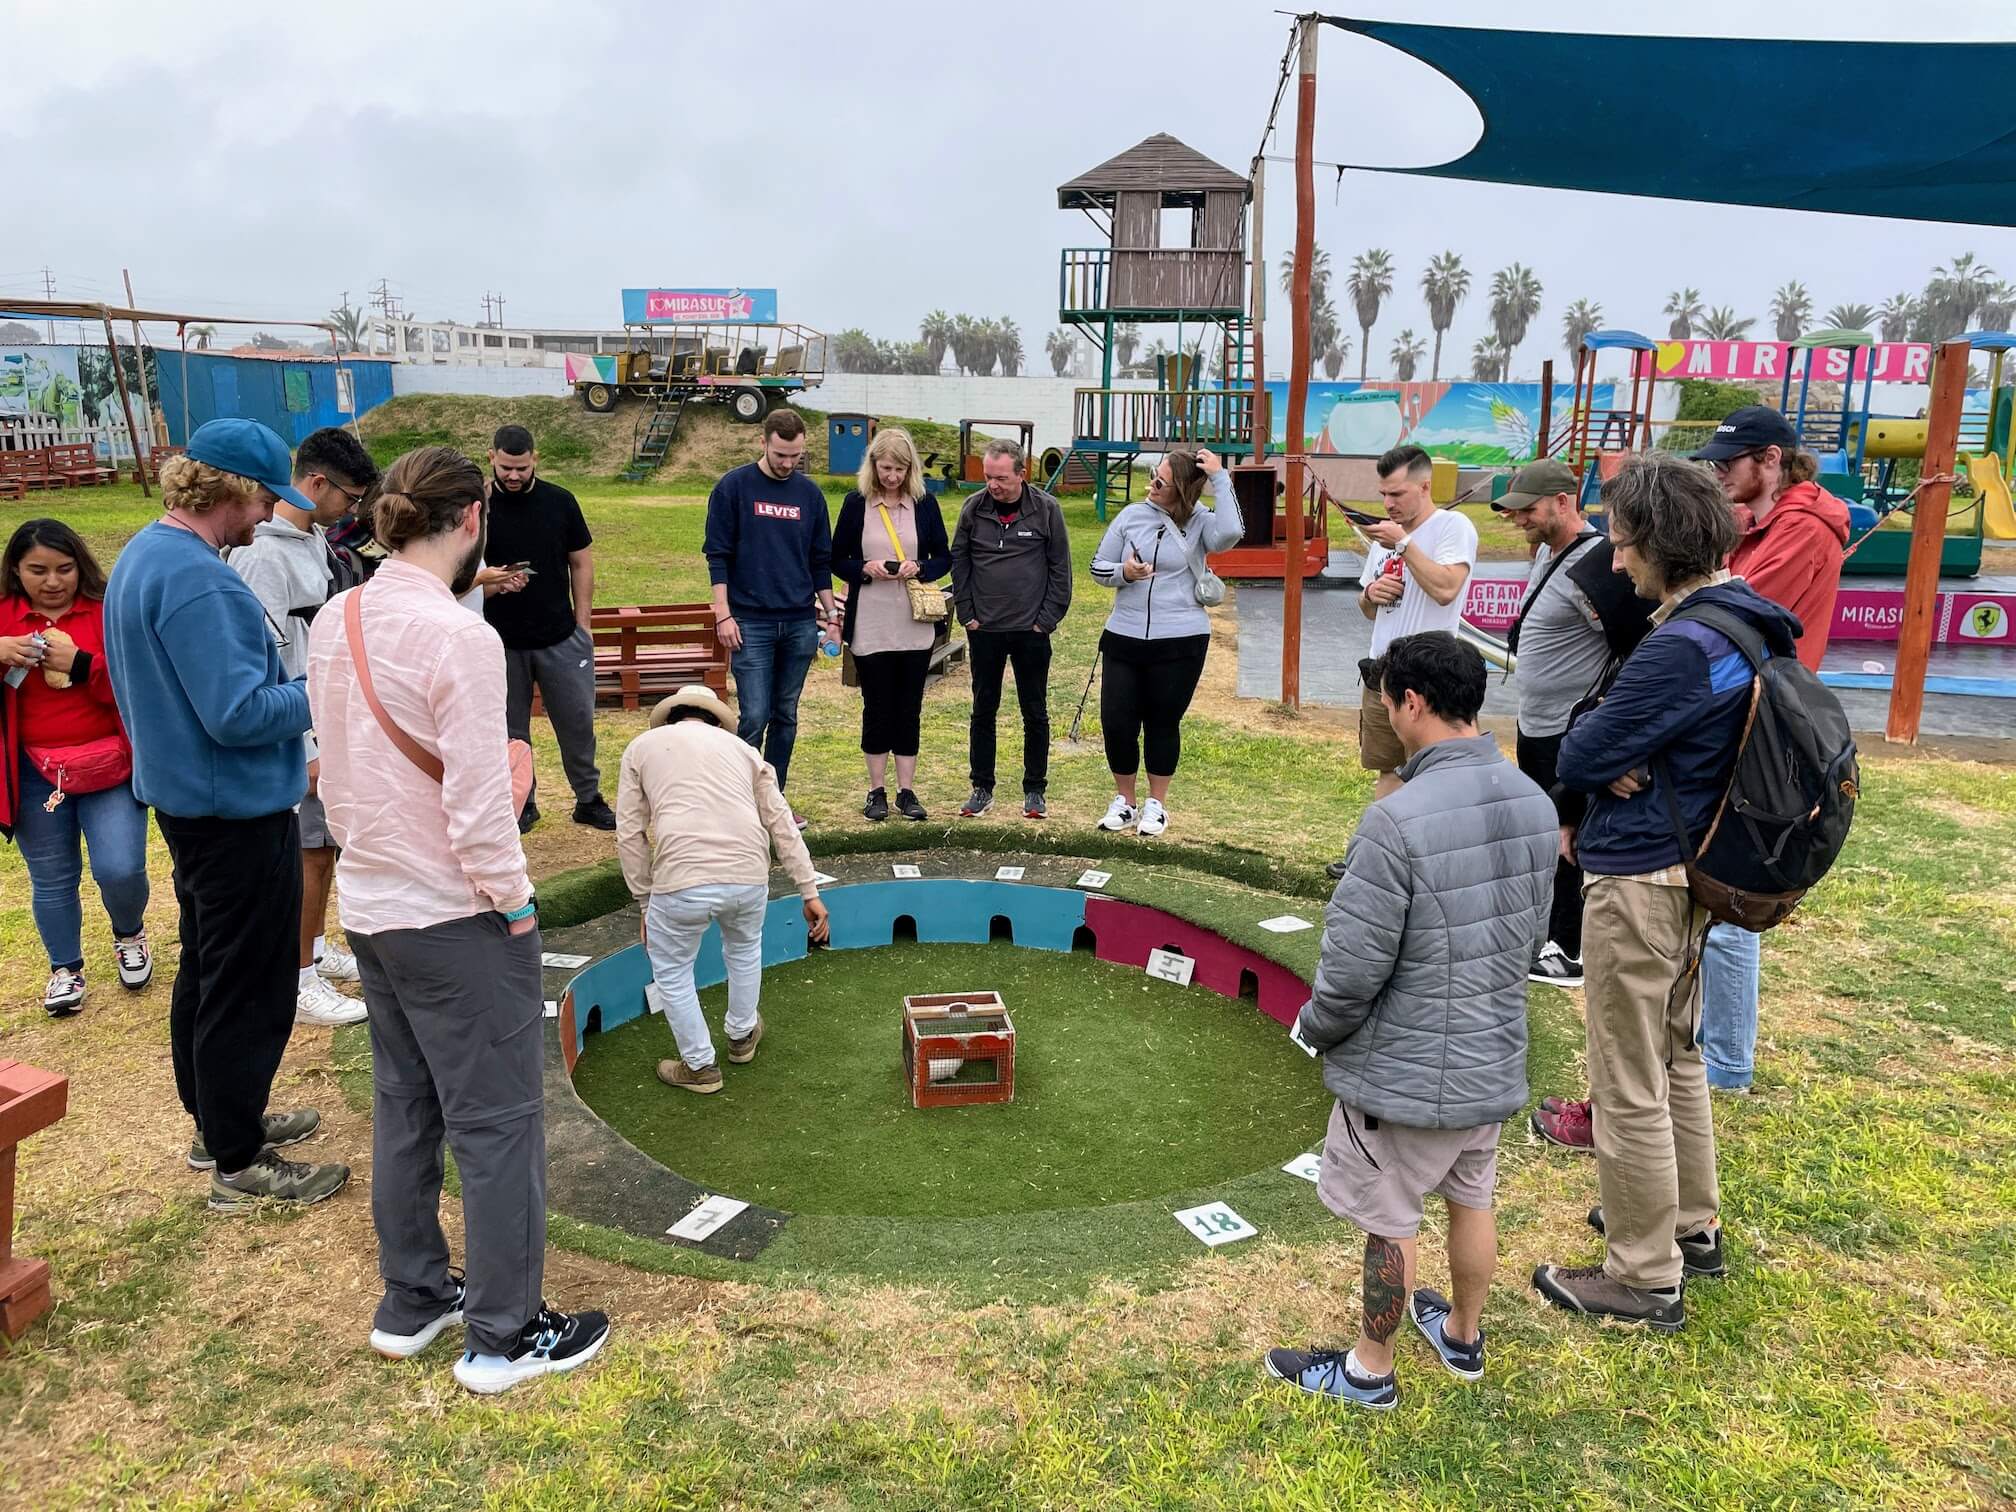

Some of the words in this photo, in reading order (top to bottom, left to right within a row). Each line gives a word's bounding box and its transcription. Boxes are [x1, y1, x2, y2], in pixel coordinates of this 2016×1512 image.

[664, 297, 726, 312] MIRASUR
[1474, 585, 1519, 600] GRAN
[1841, 606, 1904, 624] MIRAS
[1195, 1212, 1241, 1237] 18
